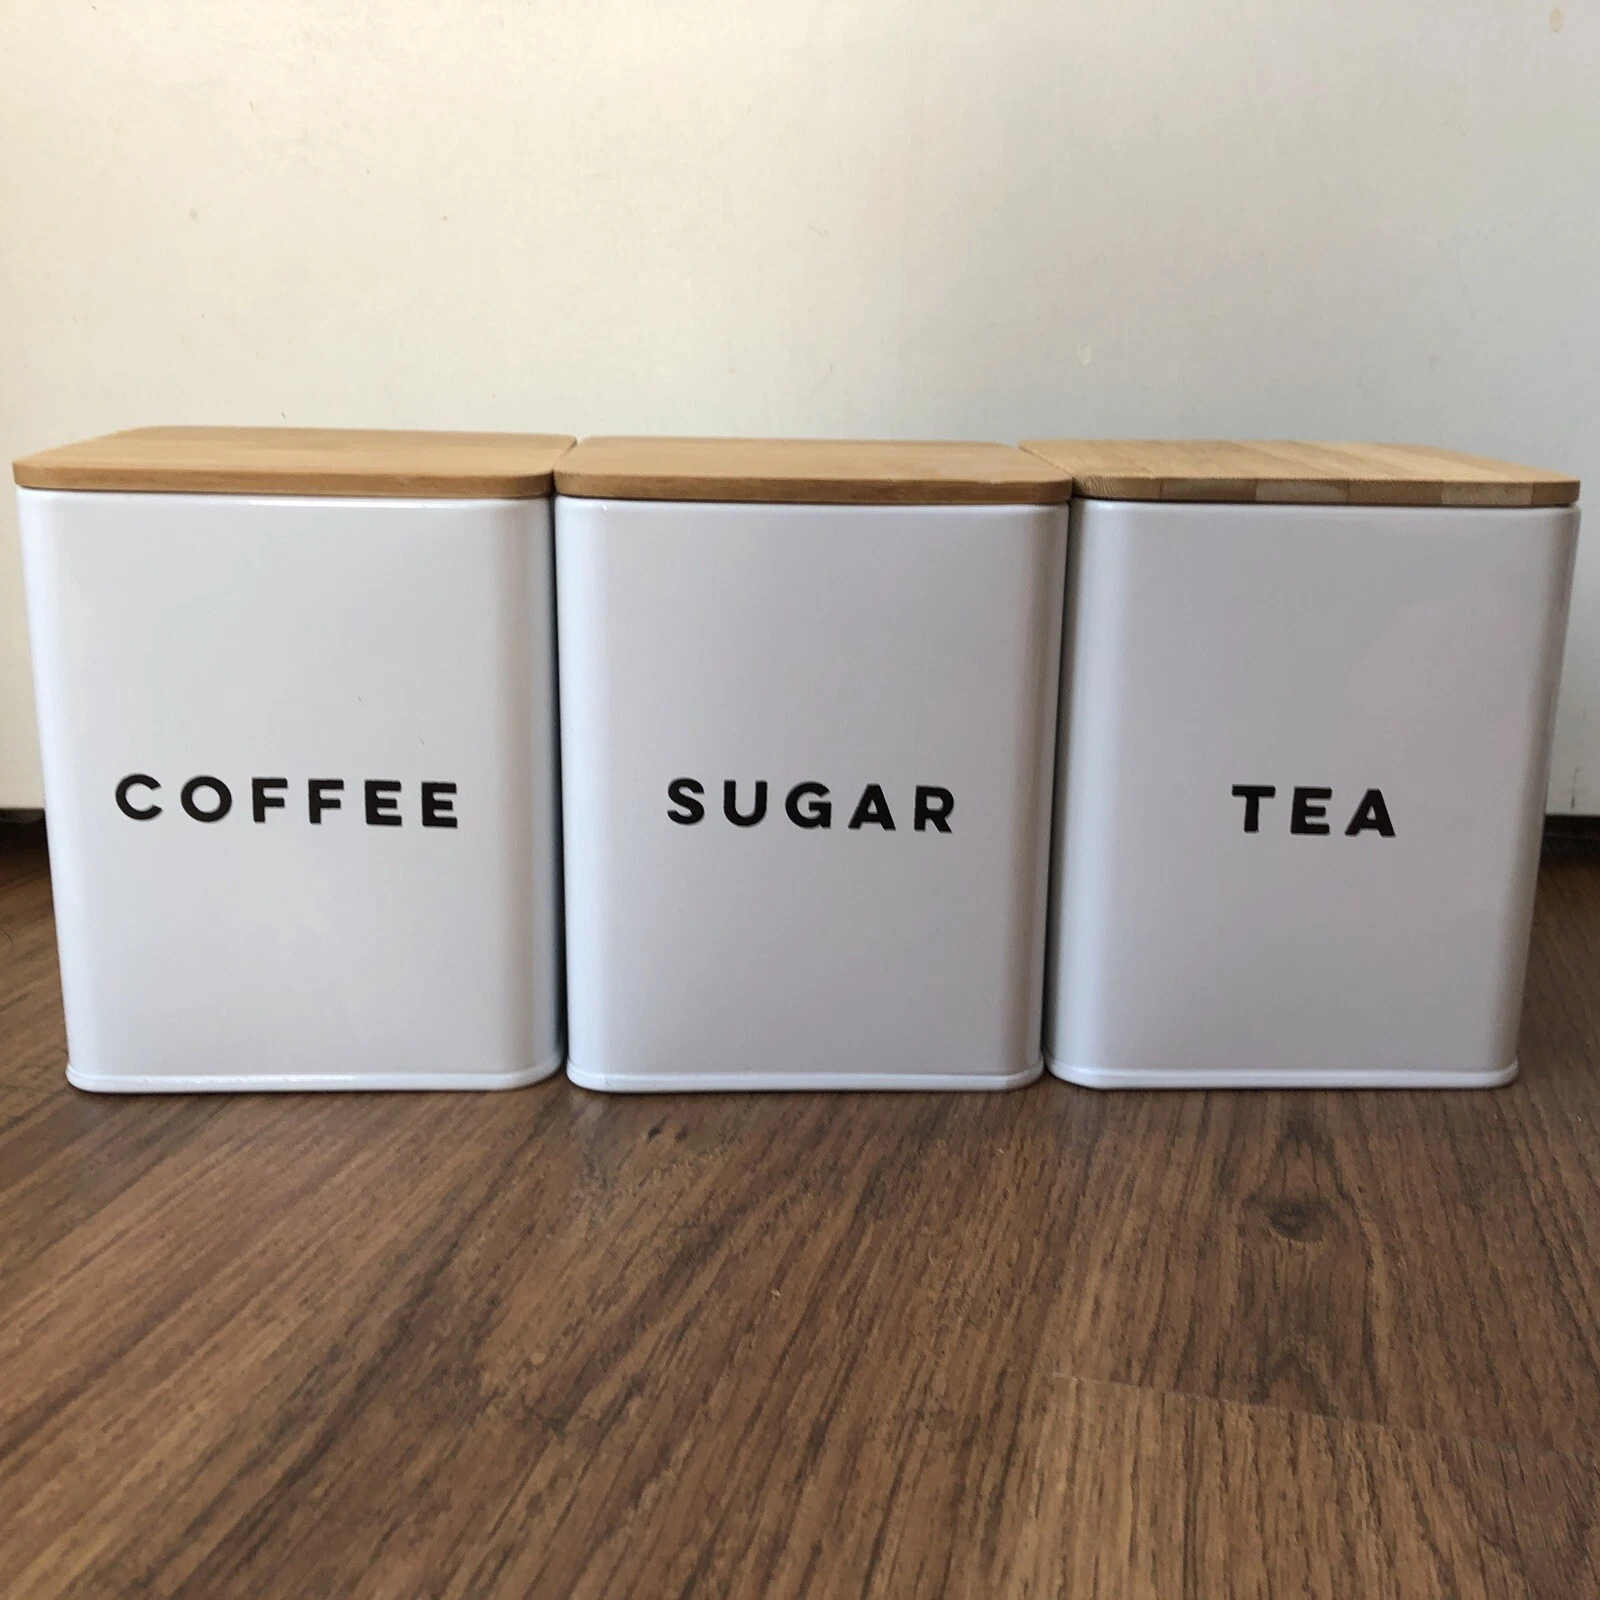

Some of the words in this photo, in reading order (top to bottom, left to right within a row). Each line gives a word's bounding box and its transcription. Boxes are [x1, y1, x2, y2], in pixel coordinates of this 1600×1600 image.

[115, 773, 459, 828] COFFEE
[667, 778, 956, 833] SUGAR
[1232, 784, 1396, 838] TEA
